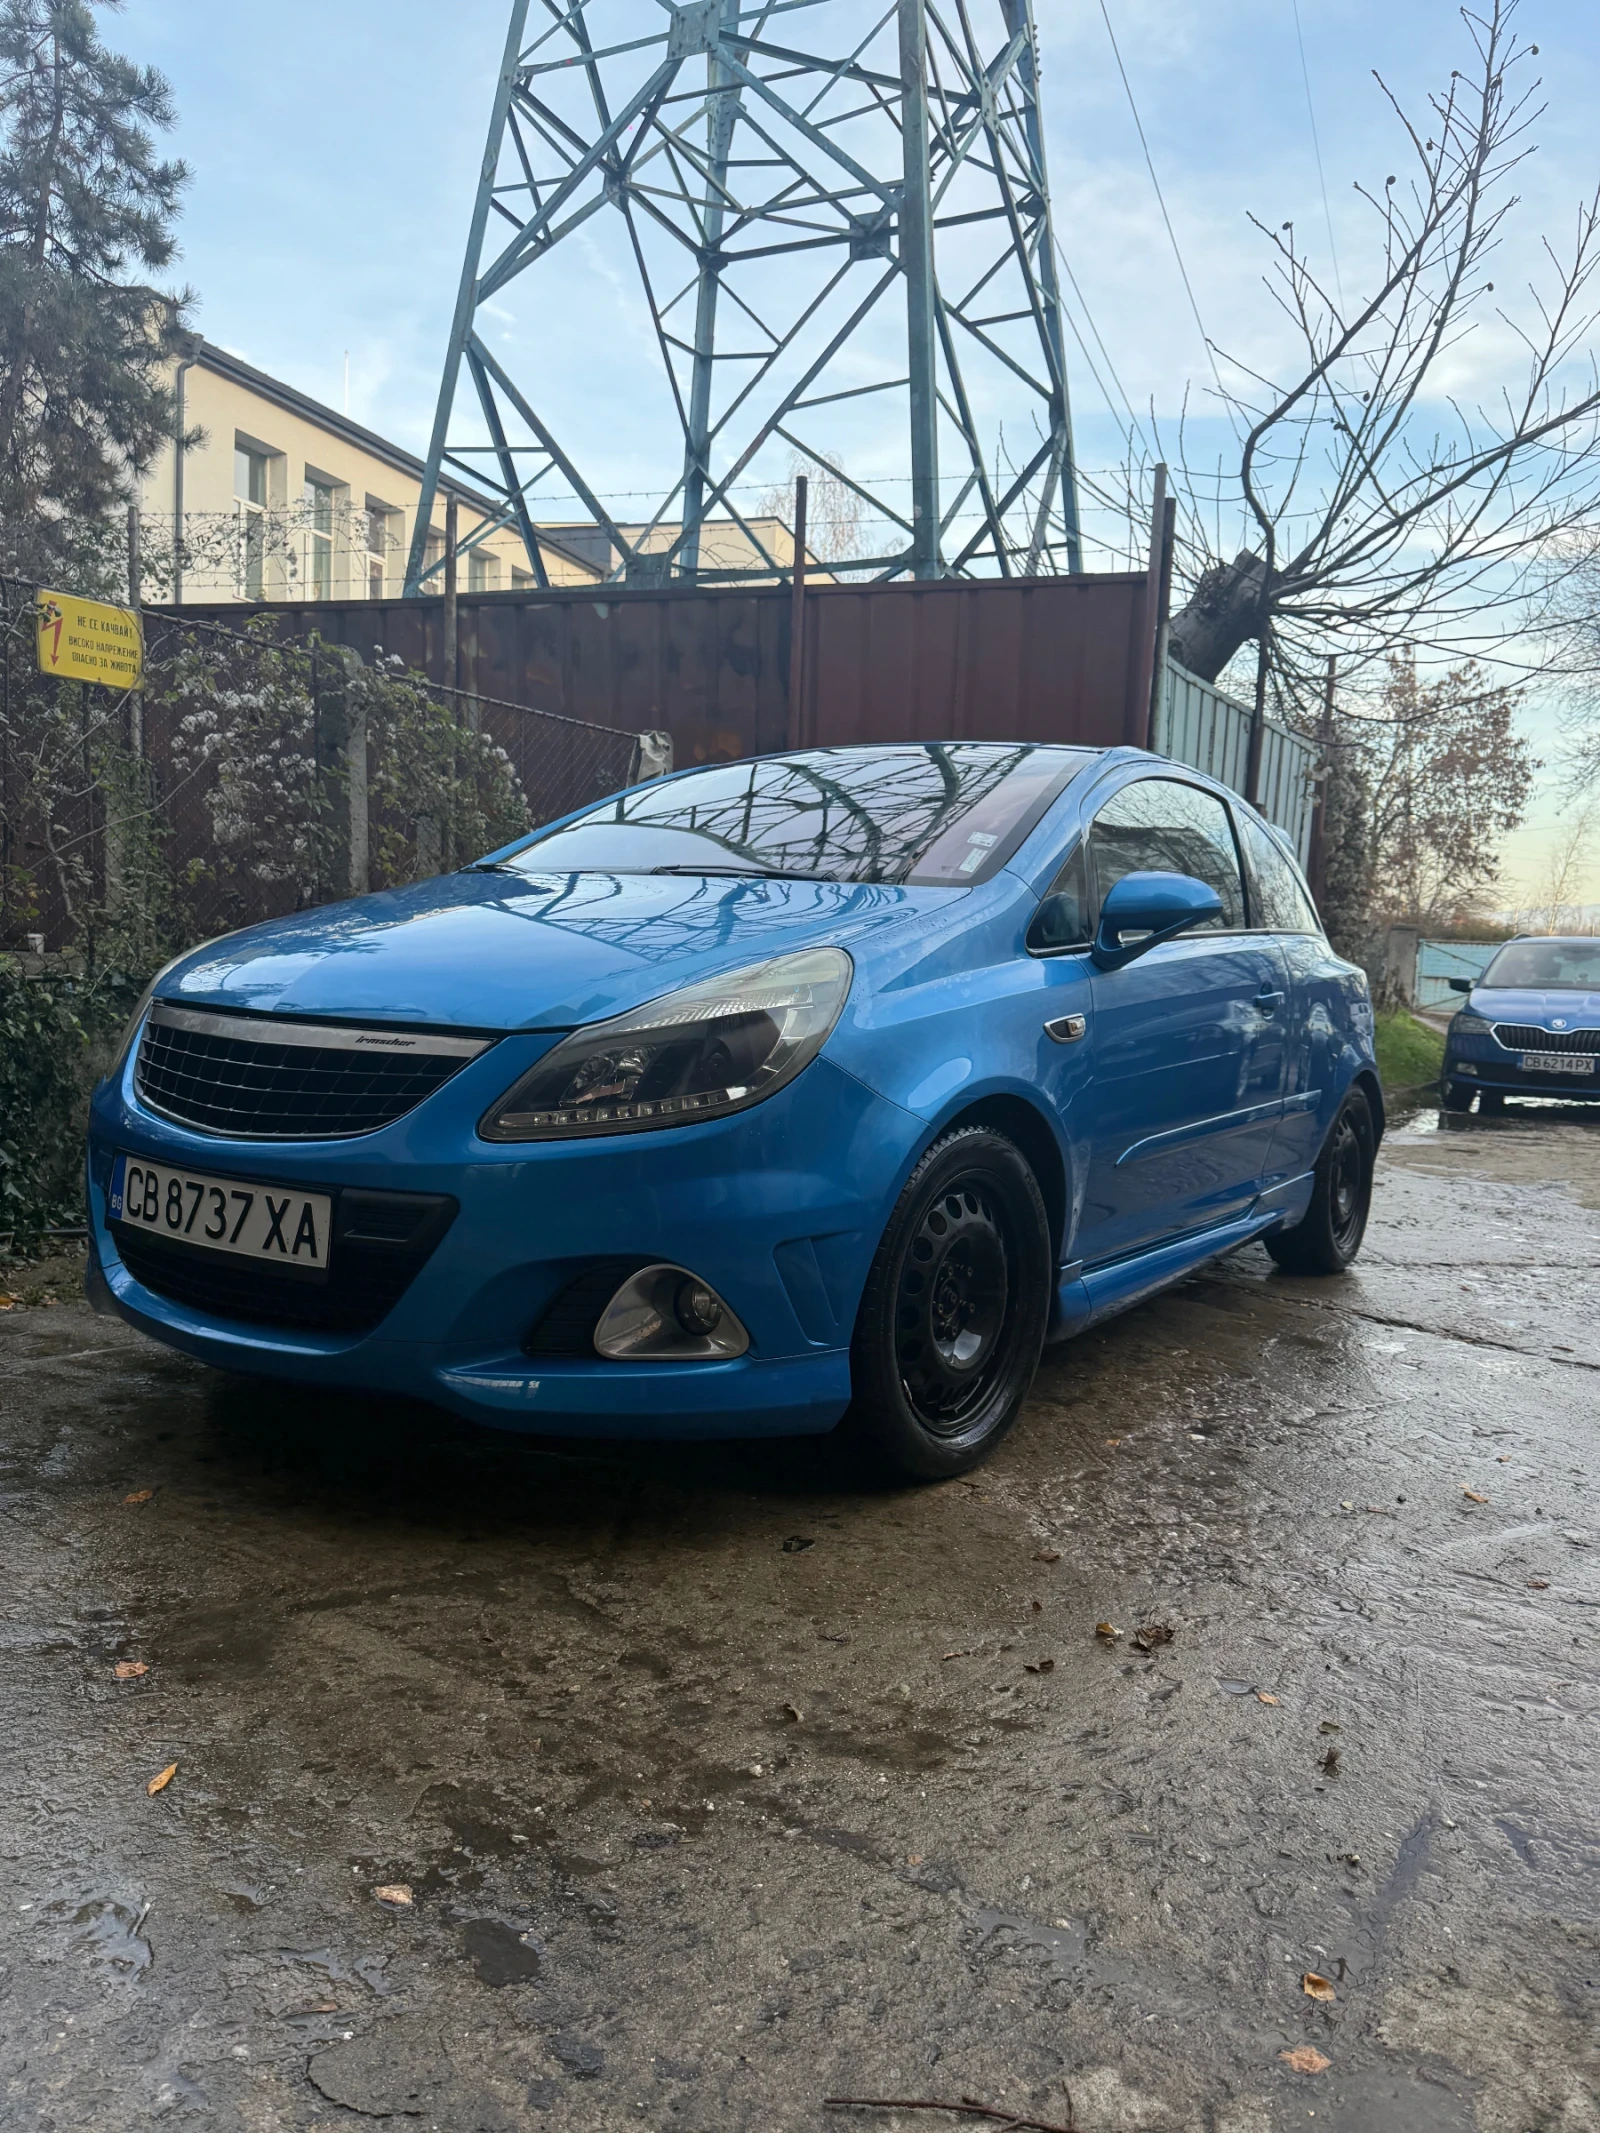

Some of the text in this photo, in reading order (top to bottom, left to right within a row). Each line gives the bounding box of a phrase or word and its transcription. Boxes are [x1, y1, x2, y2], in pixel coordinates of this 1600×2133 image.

[77, 615, 87, 627] НЕ
[89, 618, 99, 630] СЕ
[68, 635, 138, 659] ВИСОКО НАПРЕЖЕНИЕ
[72, 652, 137, 674] ОПАСНО ЗА ЖИВОТА
[111, 1193, 123, 1210] BG
[126, 1166, 318, 1258] CB 8737 XA
